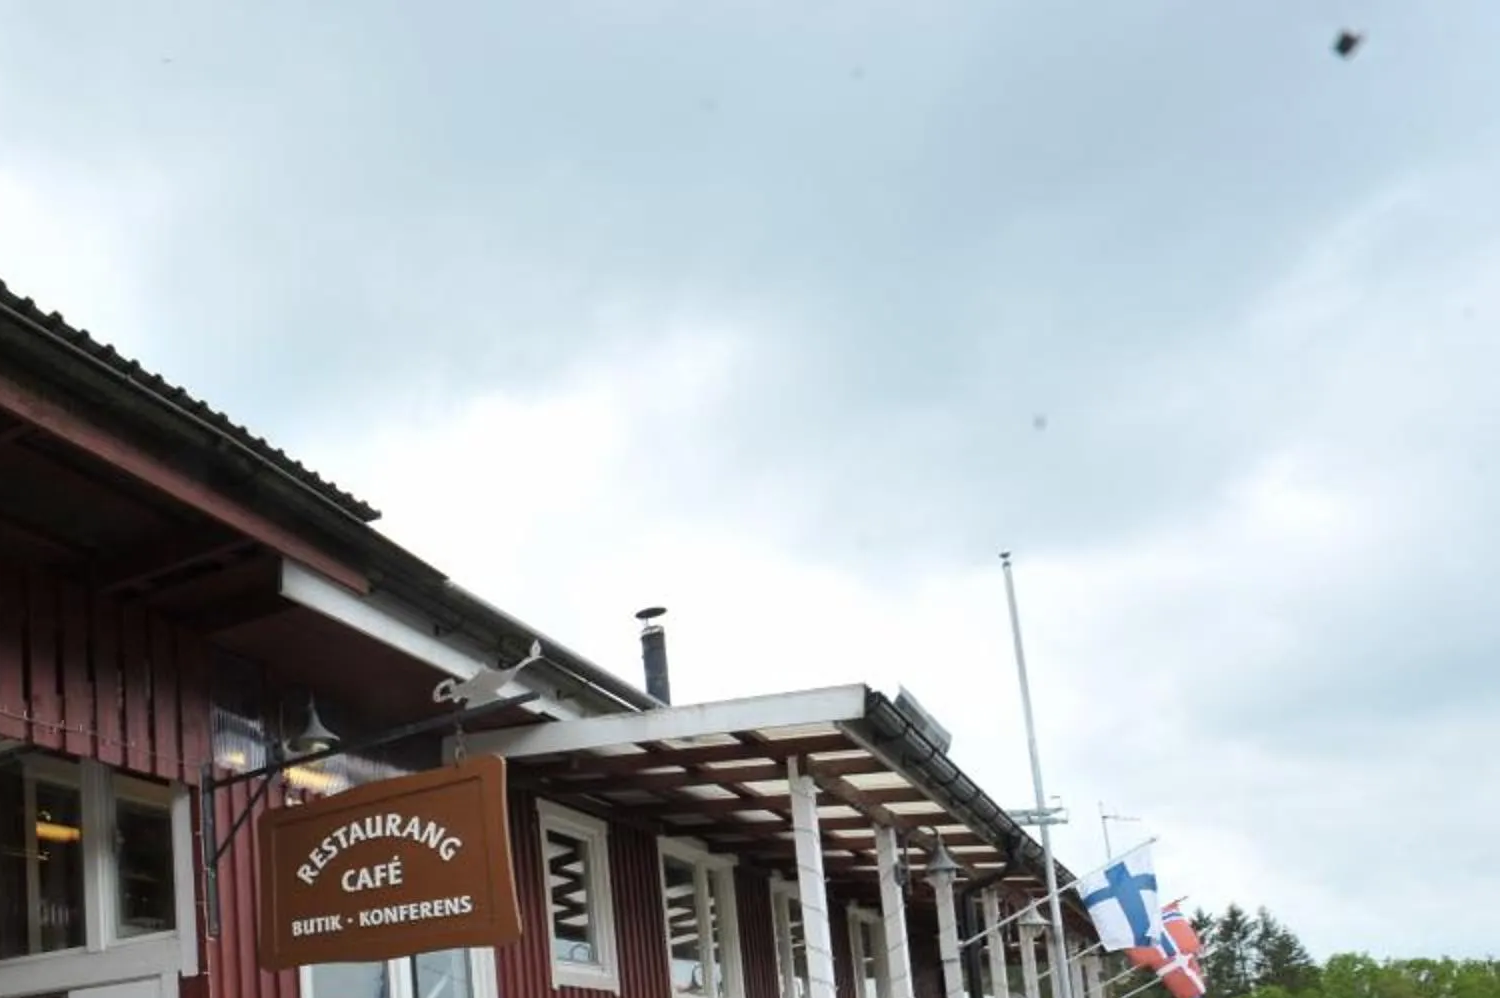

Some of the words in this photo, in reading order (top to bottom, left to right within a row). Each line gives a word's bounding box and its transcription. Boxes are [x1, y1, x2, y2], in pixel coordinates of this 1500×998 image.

[297, 813, 462, 886] RESTAURANG
[341, 855, 403, 893] CAFÉ
[292, 915, 344, 937] BUTIK
[359, 895, 473, 928] KONFERENS
